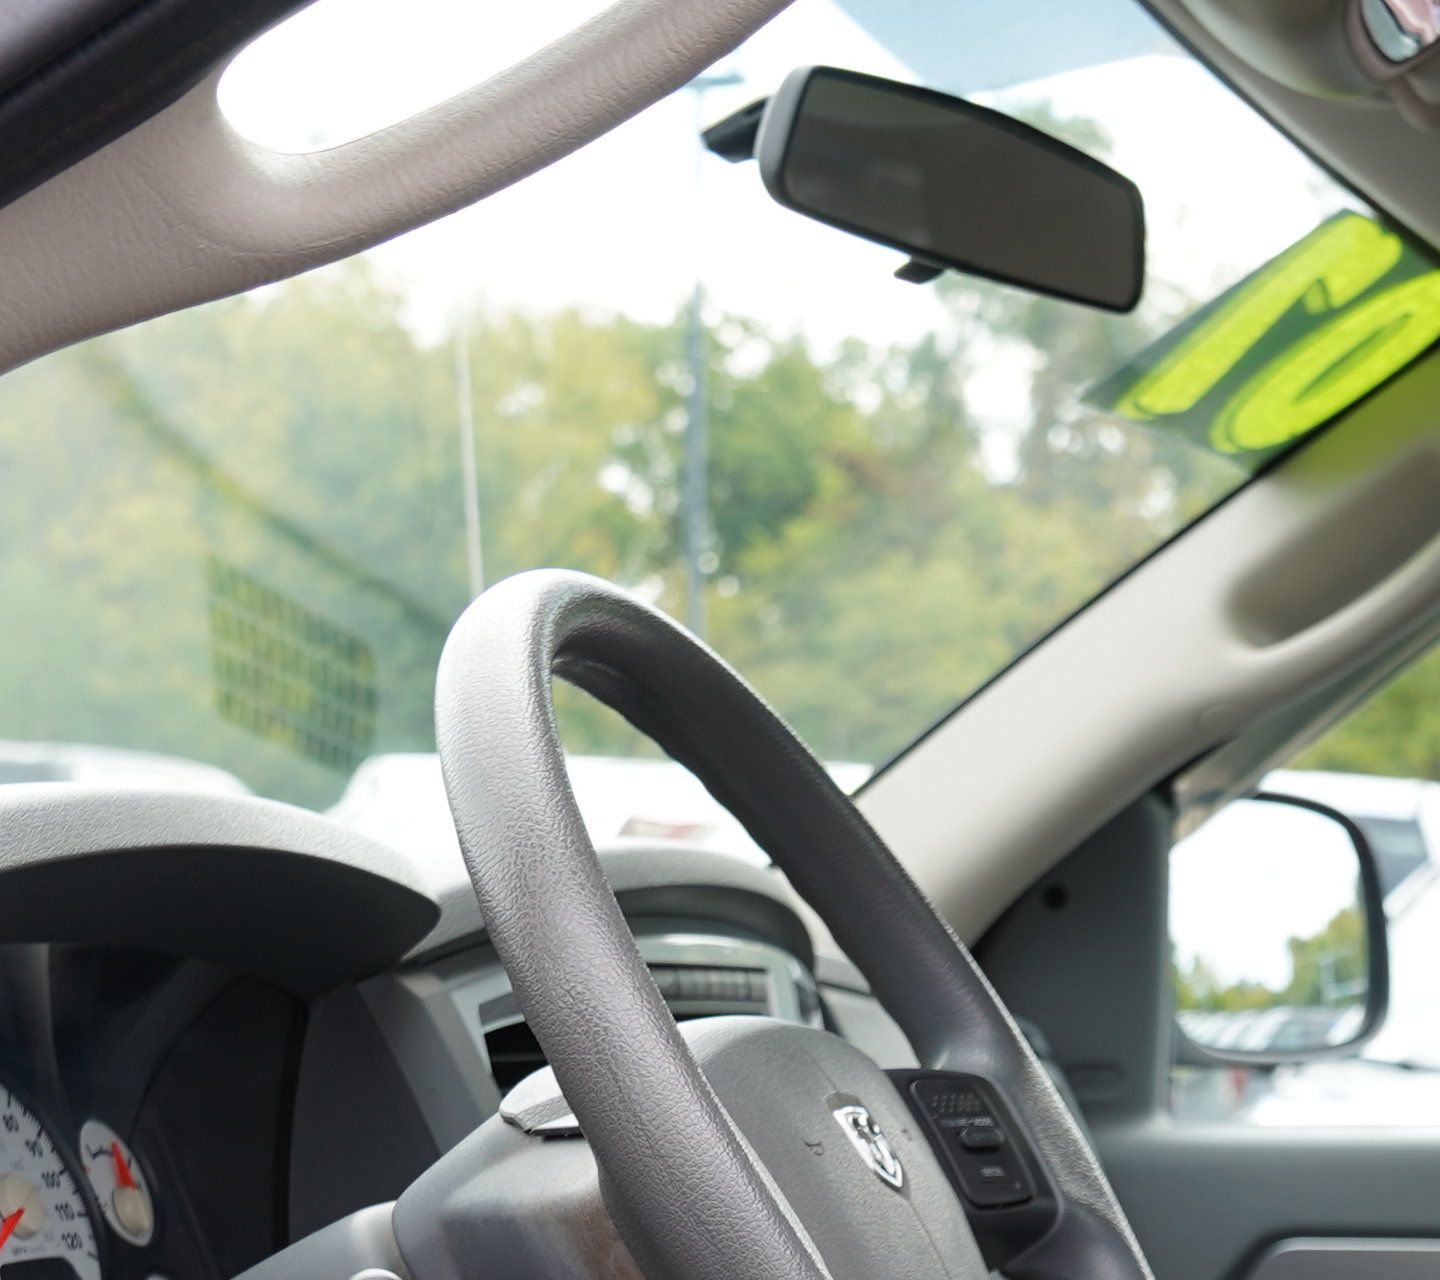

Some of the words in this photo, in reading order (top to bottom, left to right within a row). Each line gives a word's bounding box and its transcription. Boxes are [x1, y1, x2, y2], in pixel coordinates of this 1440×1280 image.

[3, 1114, 20, 1133] 80
[25, 1139, 44, 1158] 90
[41, 1171, 61, 1189] 100
[55, 1202, 76, 1221] 110
[61, 1231, 83, 1250] 120
